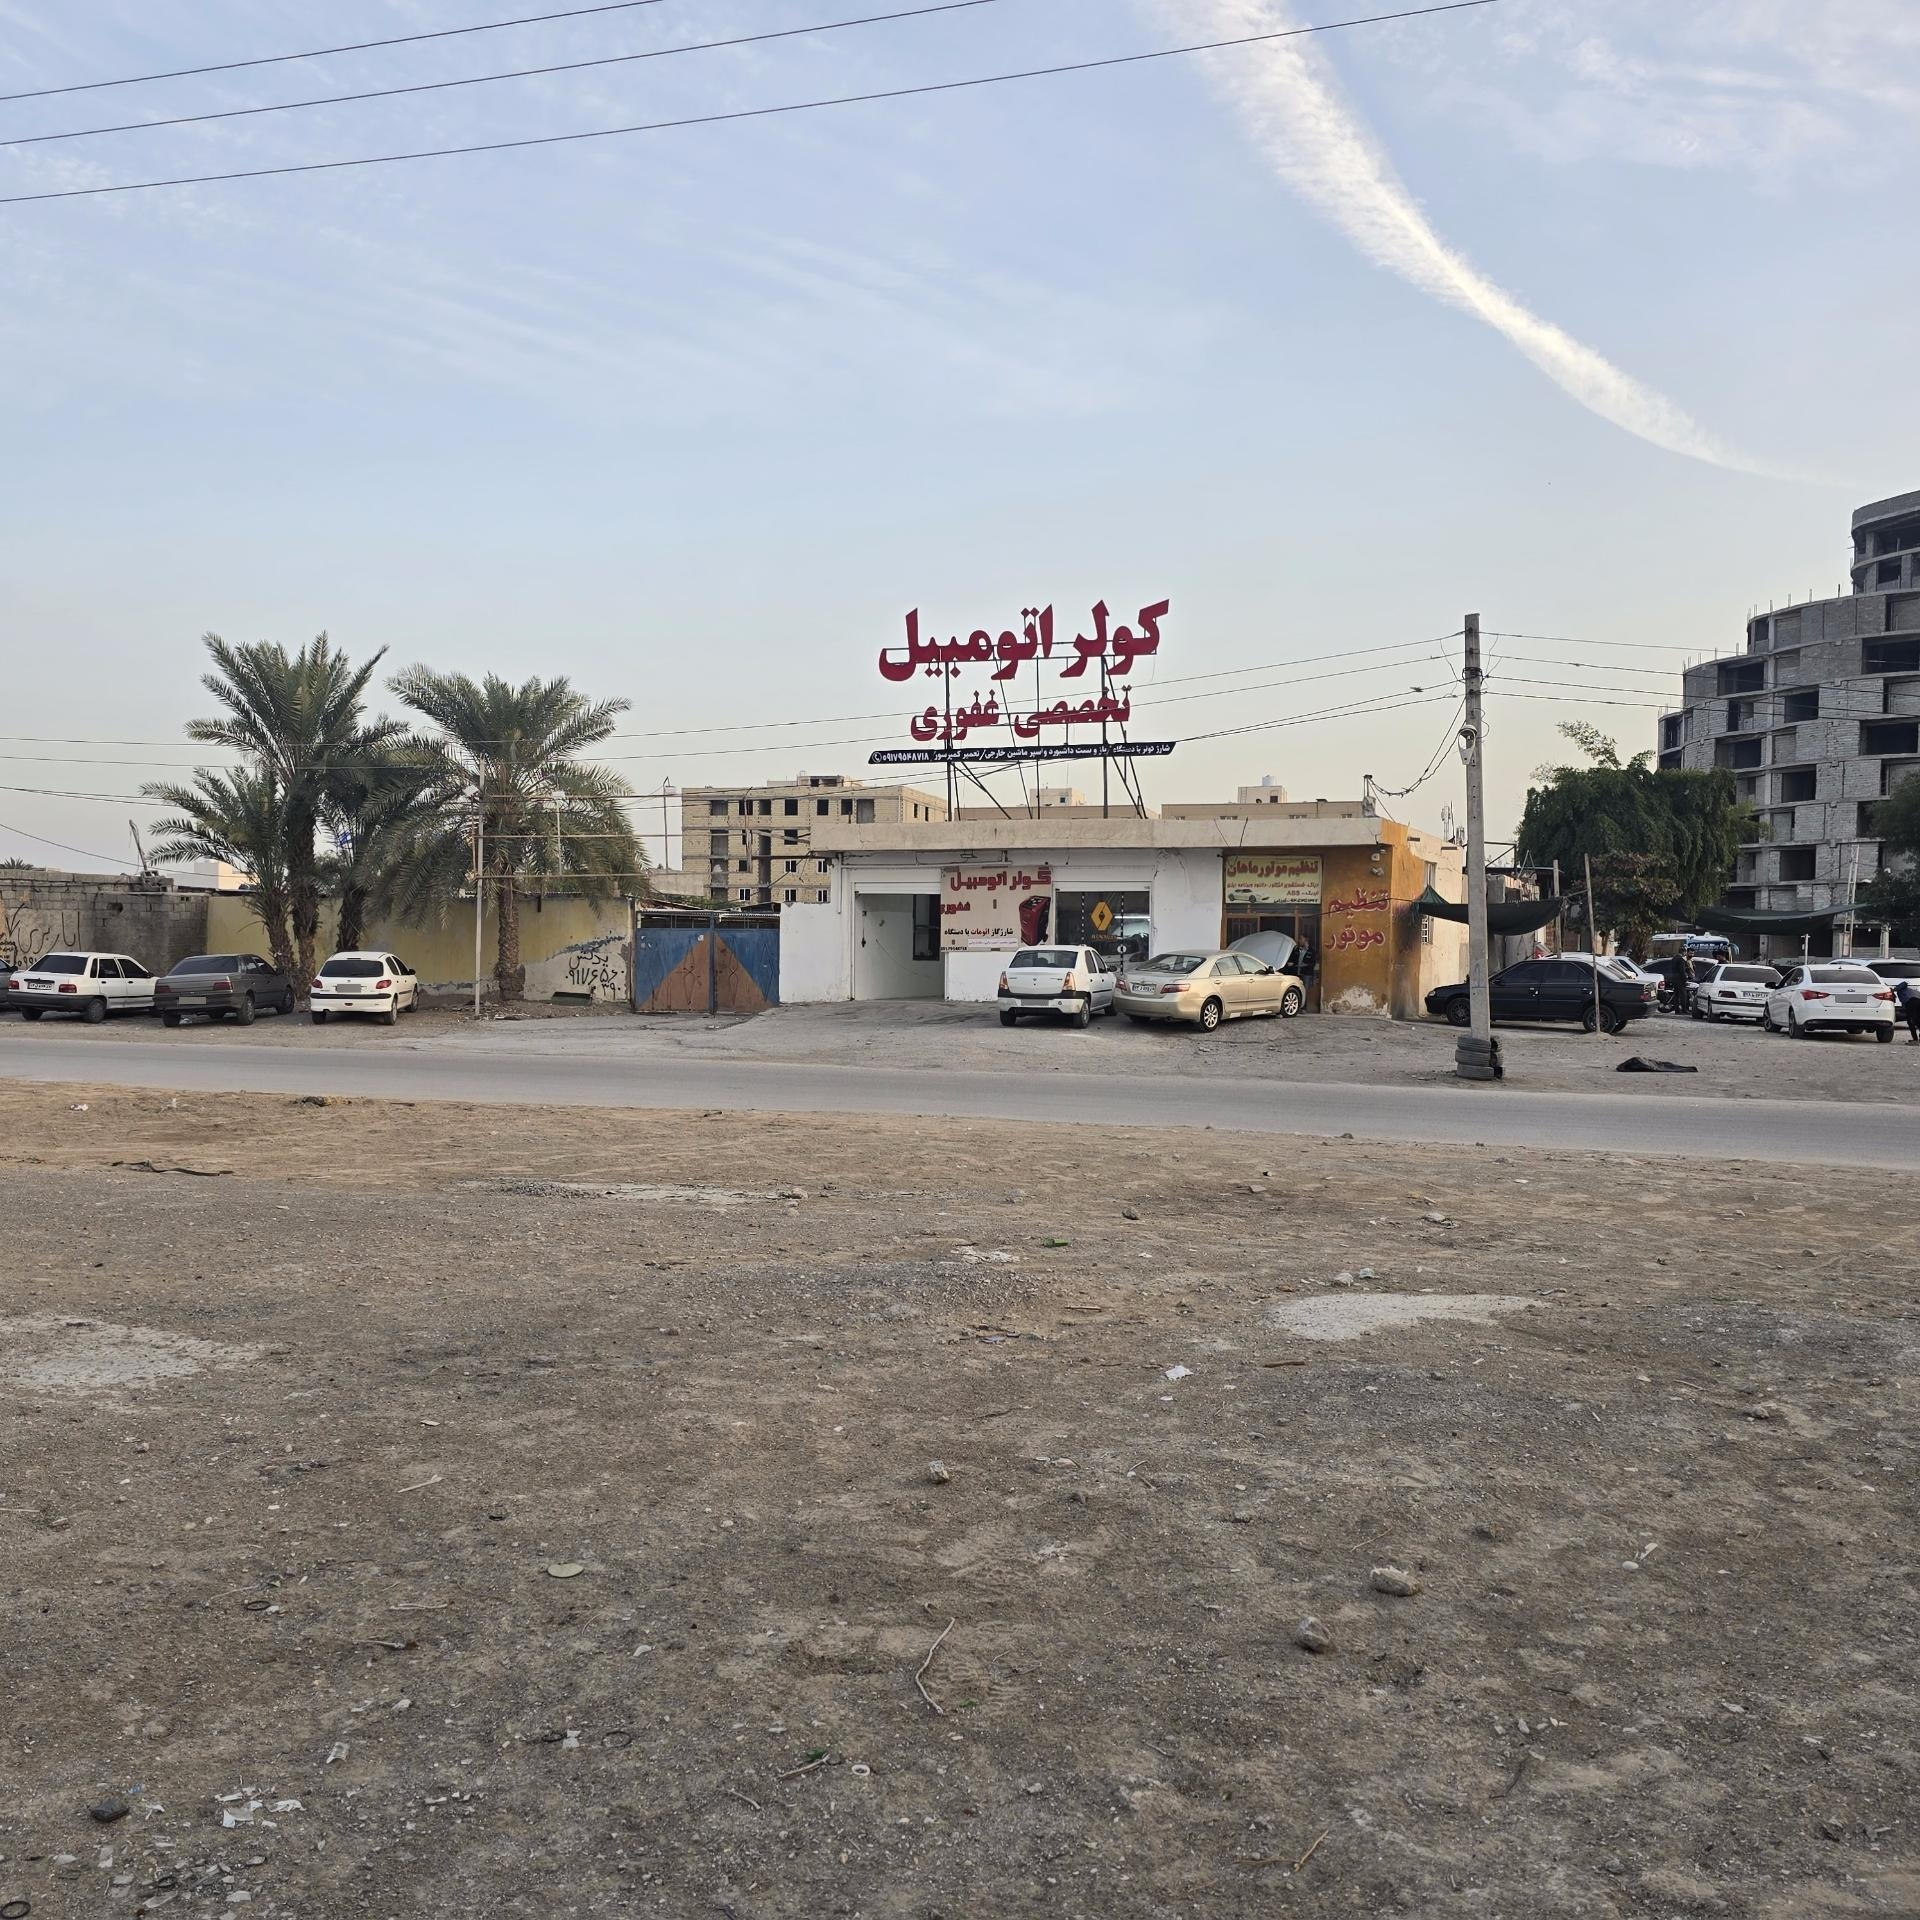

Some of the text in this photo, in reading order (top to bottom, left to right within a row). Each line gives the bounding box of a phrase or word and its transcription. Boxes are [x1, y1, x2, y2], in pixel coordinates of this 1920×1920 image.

[879, 599, 1170, 681] کولر اتومبیل
[910, 684, 1132, 741] تخصصی غفوری
[1007, 748, 1028, 758] ماشین
[950, 870, 1052, 892] کولر اتومبیل
[1257, 861, 1288, 877] موتور
[1287, 860, 1319, 877] تنظیم
[1328, 888, 1390, 919] تنظیم
[1324, 924, 1386, 952] موتور
